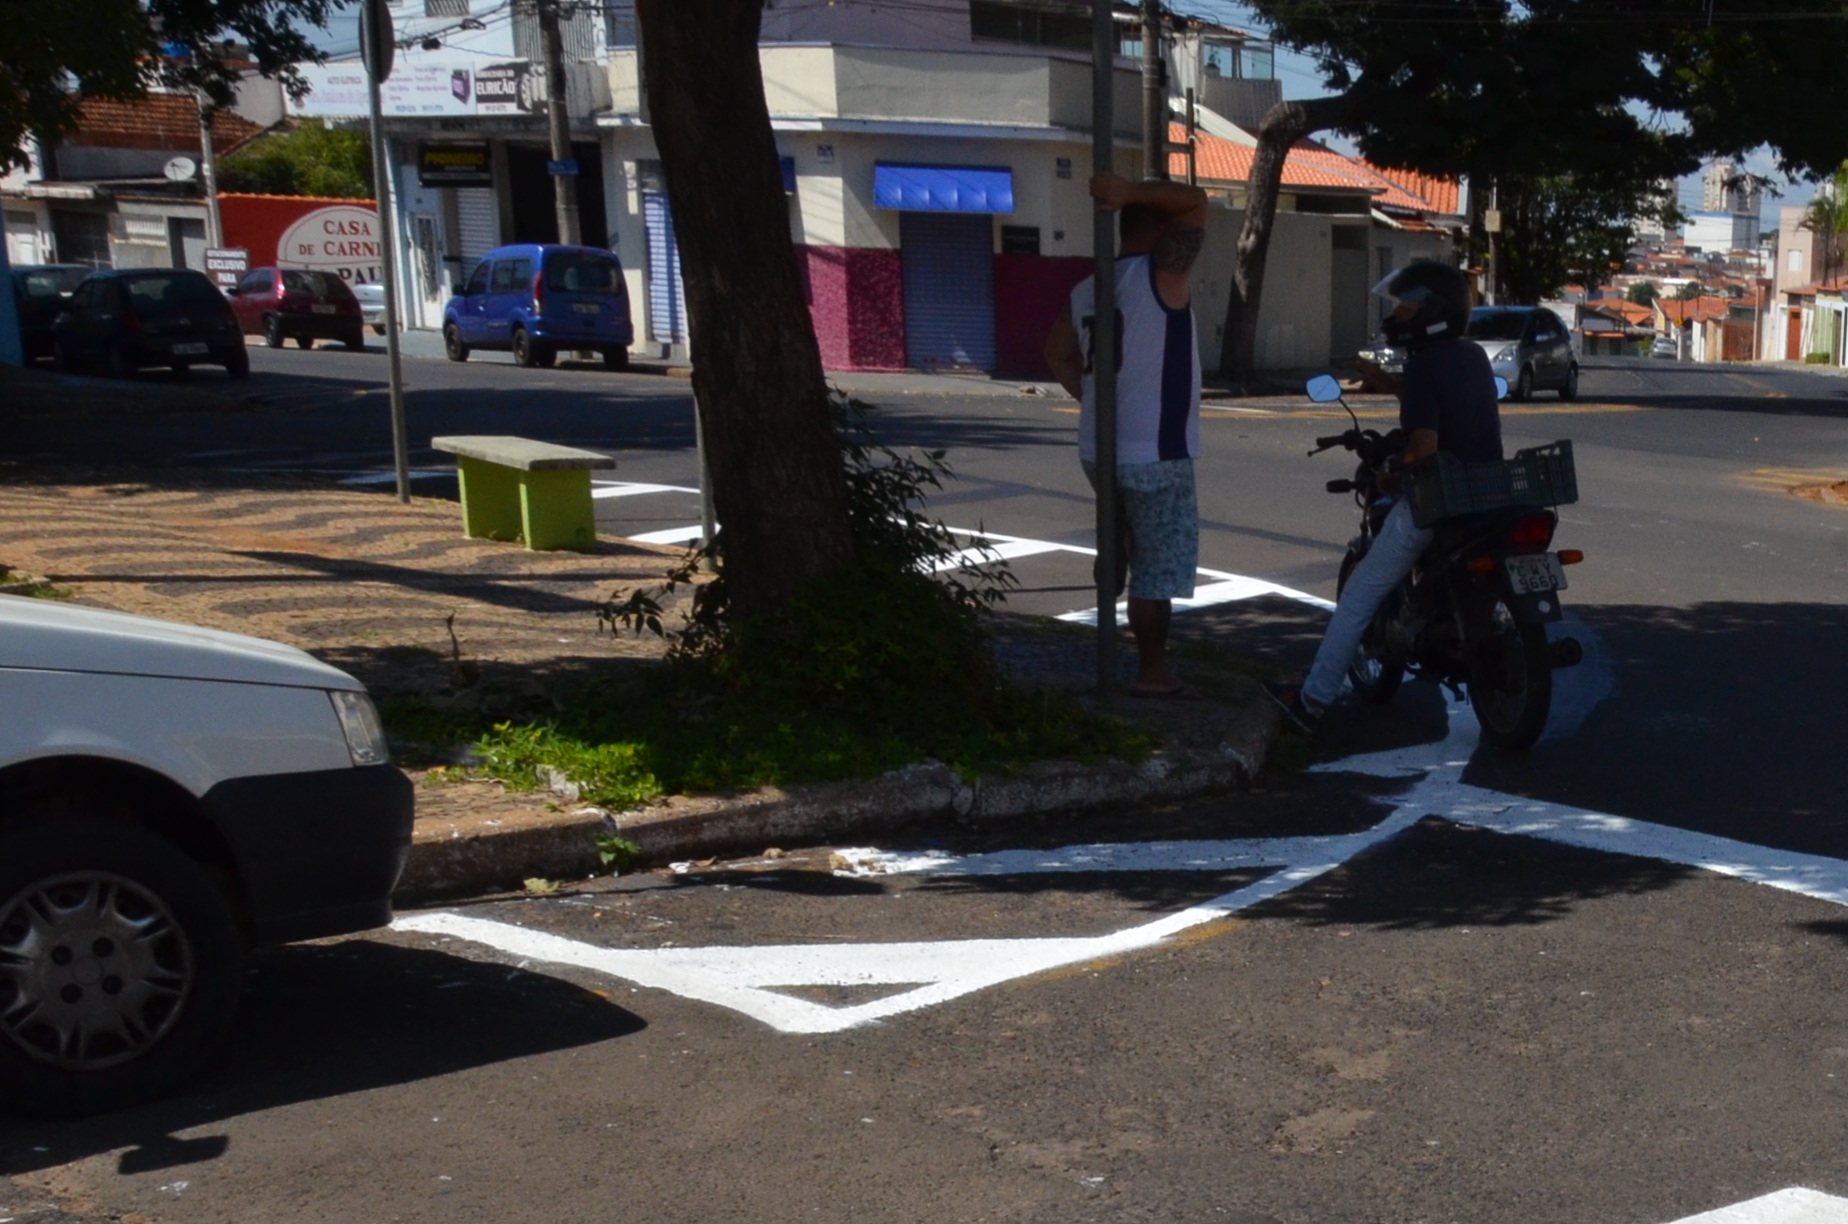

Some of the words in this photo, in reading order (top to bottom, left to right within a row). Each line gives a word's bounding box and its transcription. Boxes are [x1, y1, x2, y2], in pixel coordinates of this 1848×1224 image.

[323, 220, 371, 236] CASA
[299, 244, 316, 255] DE
[207, 259, 246, 271] EXCLUSIVO
